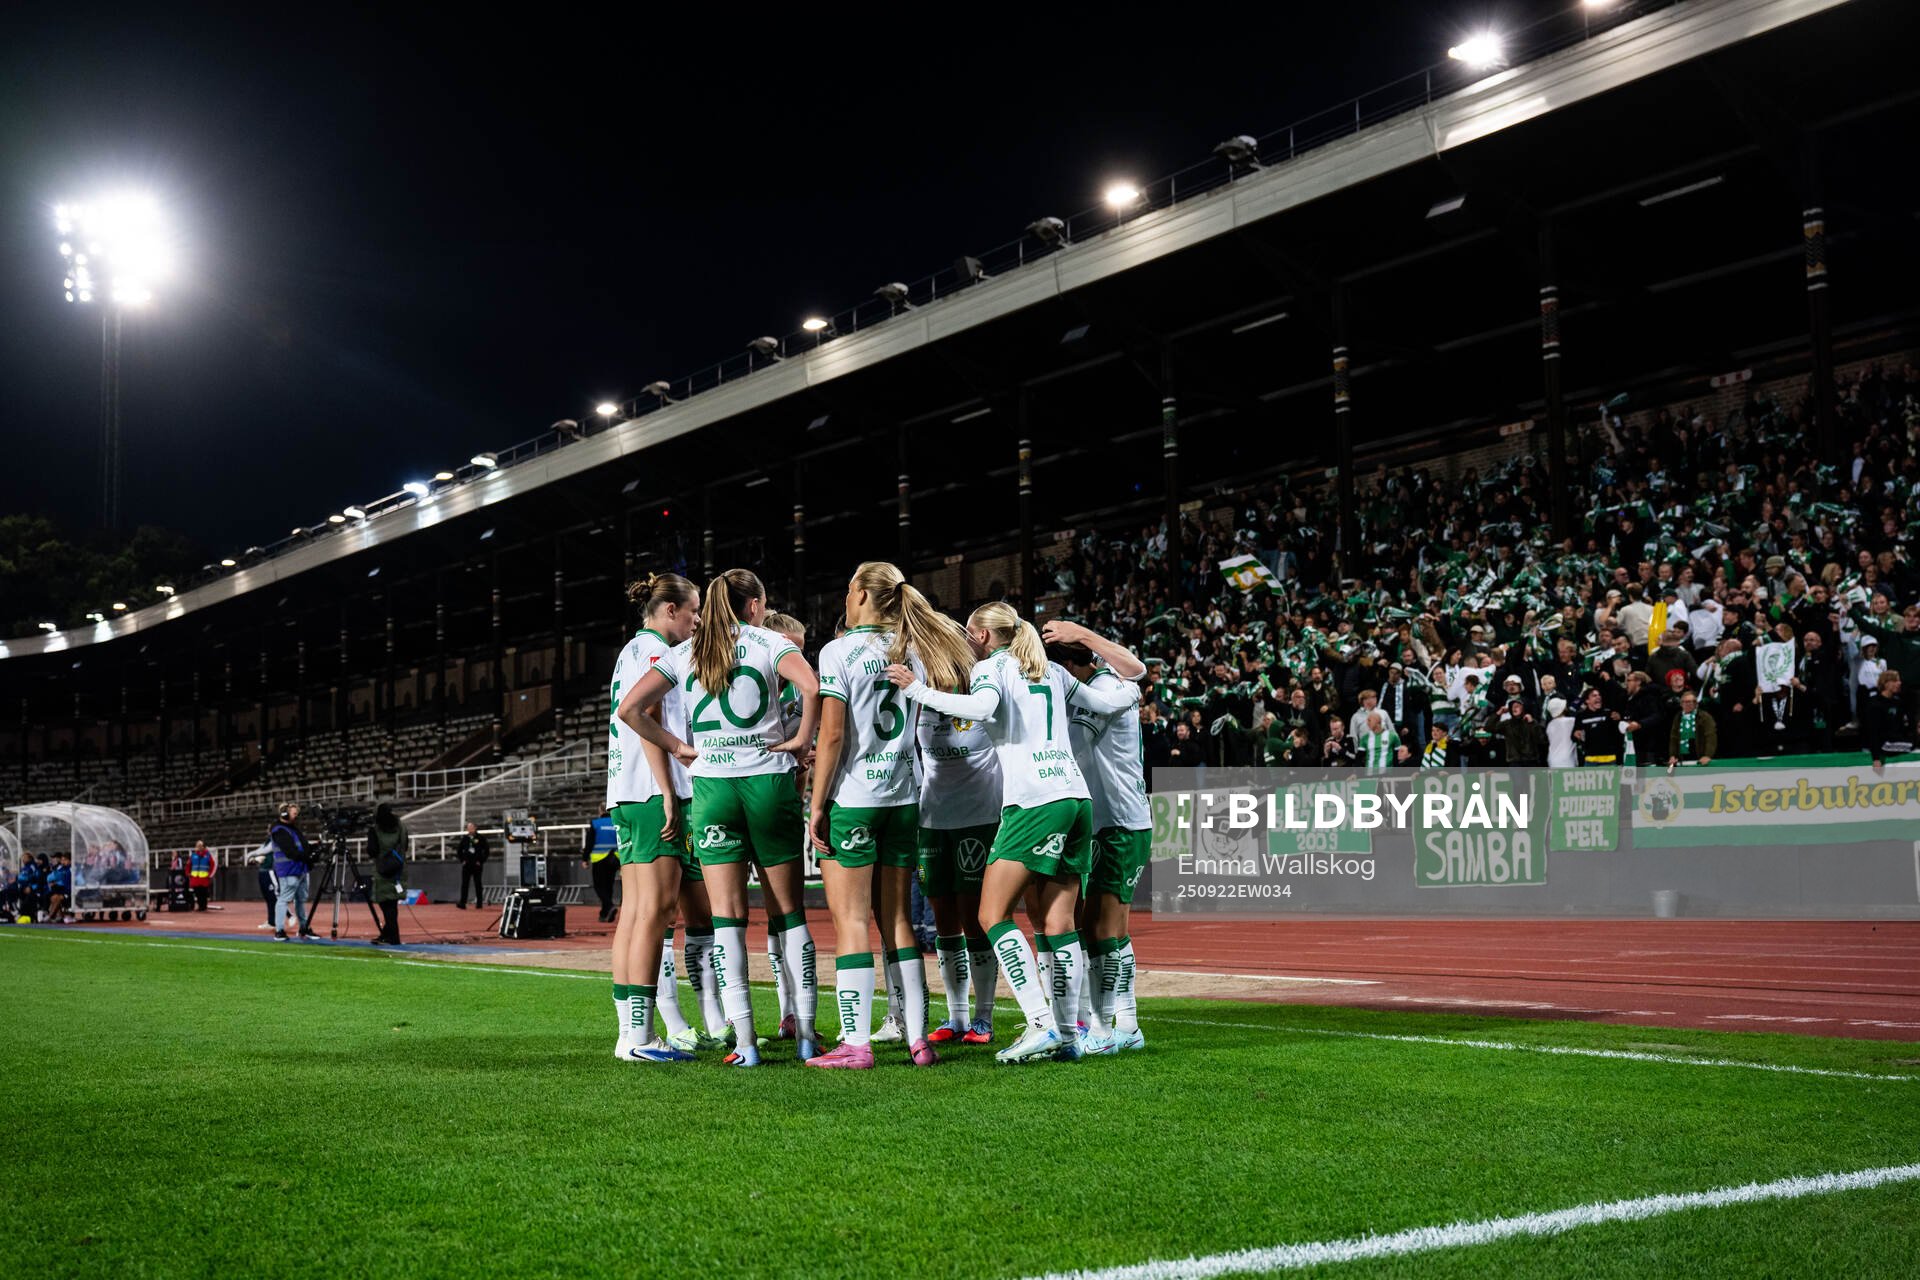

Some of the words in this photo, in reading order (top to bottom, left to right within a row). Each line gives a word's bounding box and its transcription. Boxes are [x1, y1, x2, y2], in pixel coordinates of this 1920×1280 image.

[686, 665, 769, 732] 20
[873, 680, 905, 741] 3
[1028, 684, 1053, 741] 7
[866, 769, 894, 780] BAN
[1038, 766, 1067, 779] BANK
[1563, 770, 1615, 792] PARTY
[1559, 795, 1615, 818] POOPER
[1709, 775, 1920, 814] Isterbukar
[1296, 832, 1338, 851] 2009
[1425, 830, 1532, 883] SAMBA
[998, 938, 1027, 991] Clinton.
[1053, 949, 1074, 1001] Clinton.
[631, 997, 648, 1029] nton.
[839, 989, 861, 1036] Clinton.
